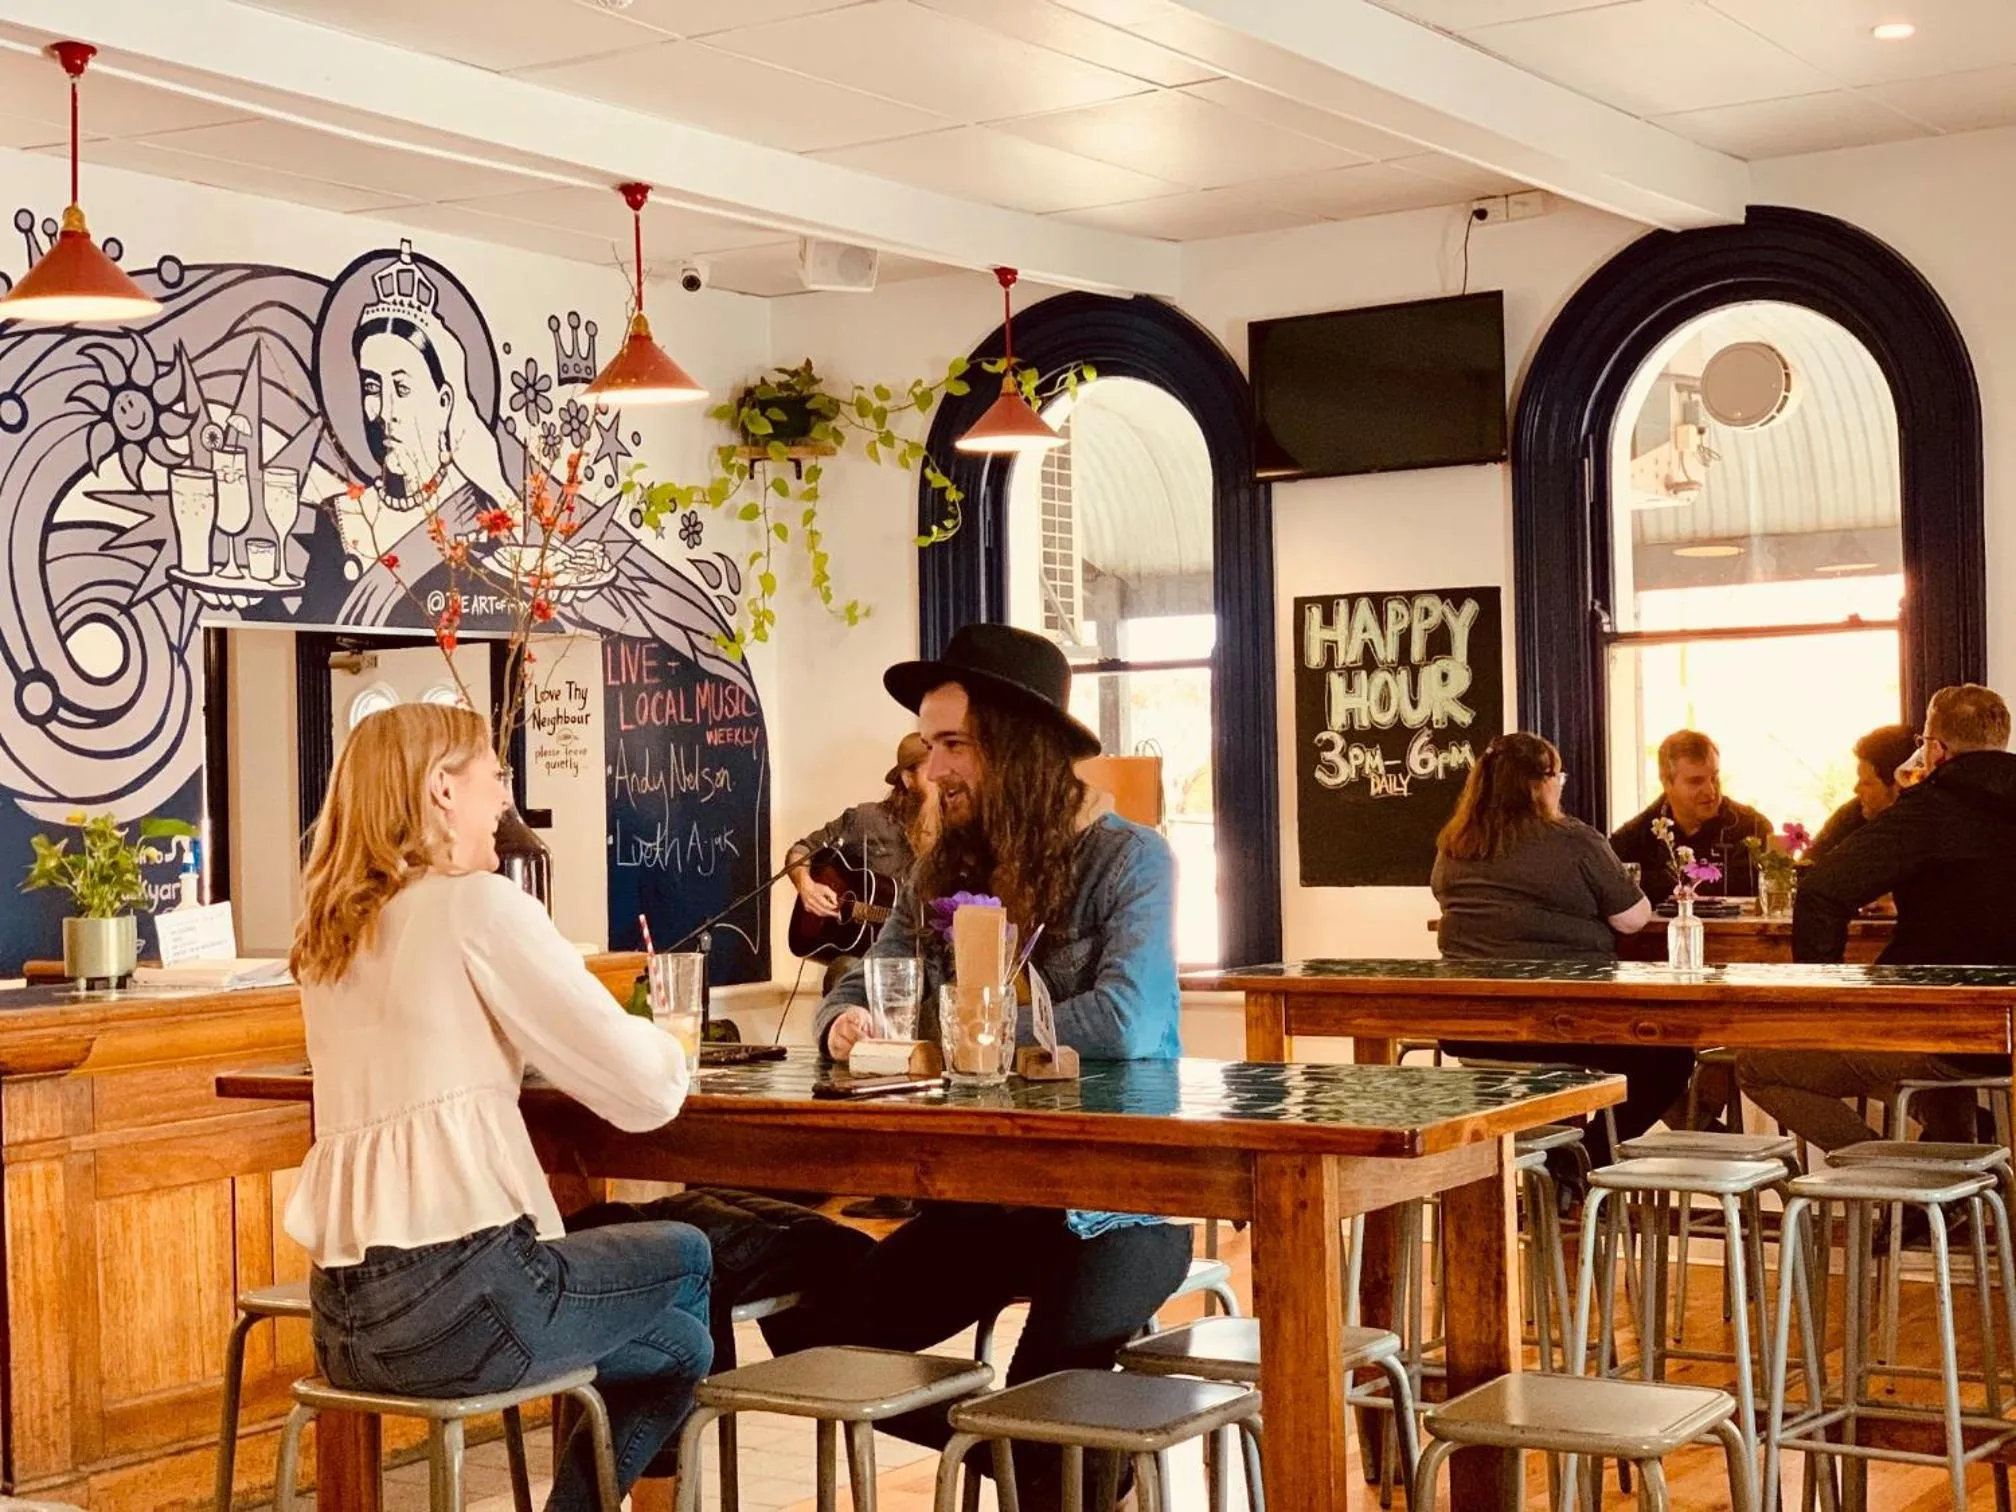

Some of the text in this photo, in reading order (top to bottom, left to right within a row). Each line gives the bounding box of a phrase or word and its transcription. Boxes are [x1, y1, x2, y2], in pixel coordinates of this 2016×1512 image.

[1304, 594, 1480, 668] HAPPY
[606, 639, 661, 686] LIVE
[534, 680, 588, 710] Love Thy
[619, 678, 758, 731] LOCAL MUSIC
[1326, 656, 1476, 730] HOUR
[532, 707, 591, 736] Neighbour
[705, 726, 759, 760] WEEKLY
[545, 757, 579, 777] quietly
[615, 738, 732, 826] Andy Nelson
[1370, 772, 1412, 797] DAILY
